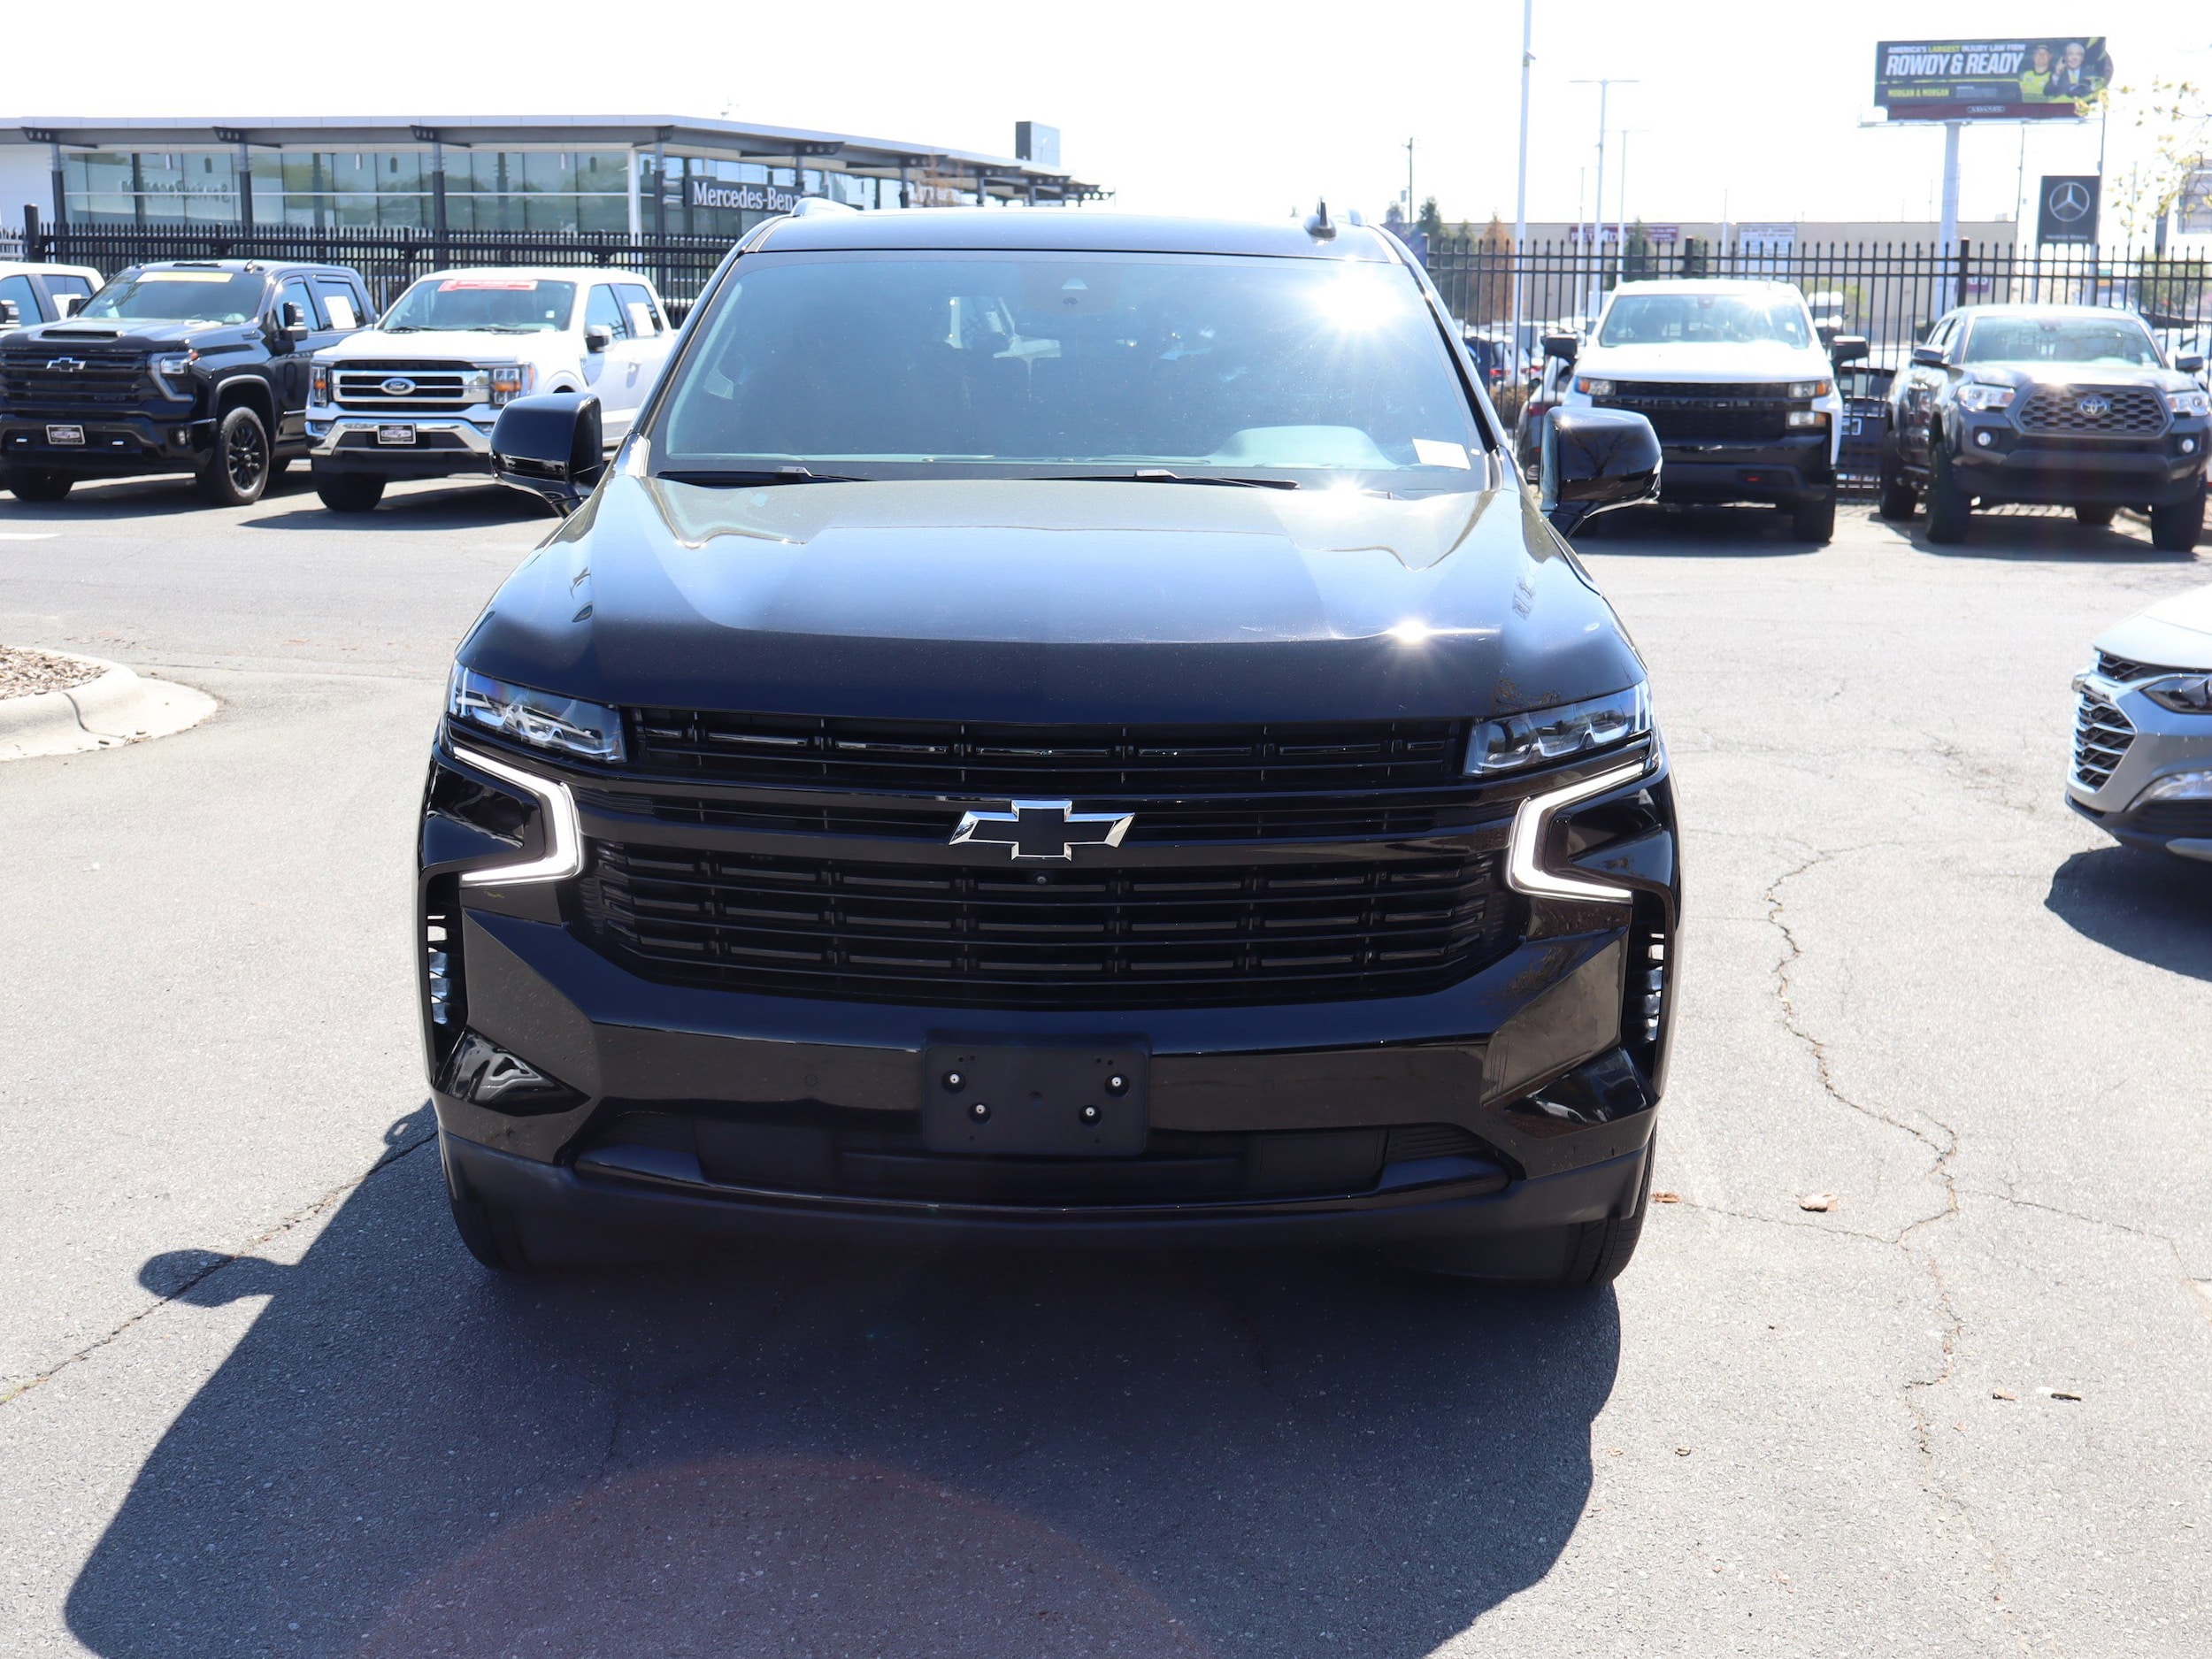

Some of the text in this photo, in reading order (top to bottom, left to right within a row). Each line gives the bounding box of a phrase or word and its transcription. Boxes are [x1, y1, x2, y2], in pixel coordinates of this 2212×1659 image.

[1886, 52, 2024, 76] ROWDY & READY
